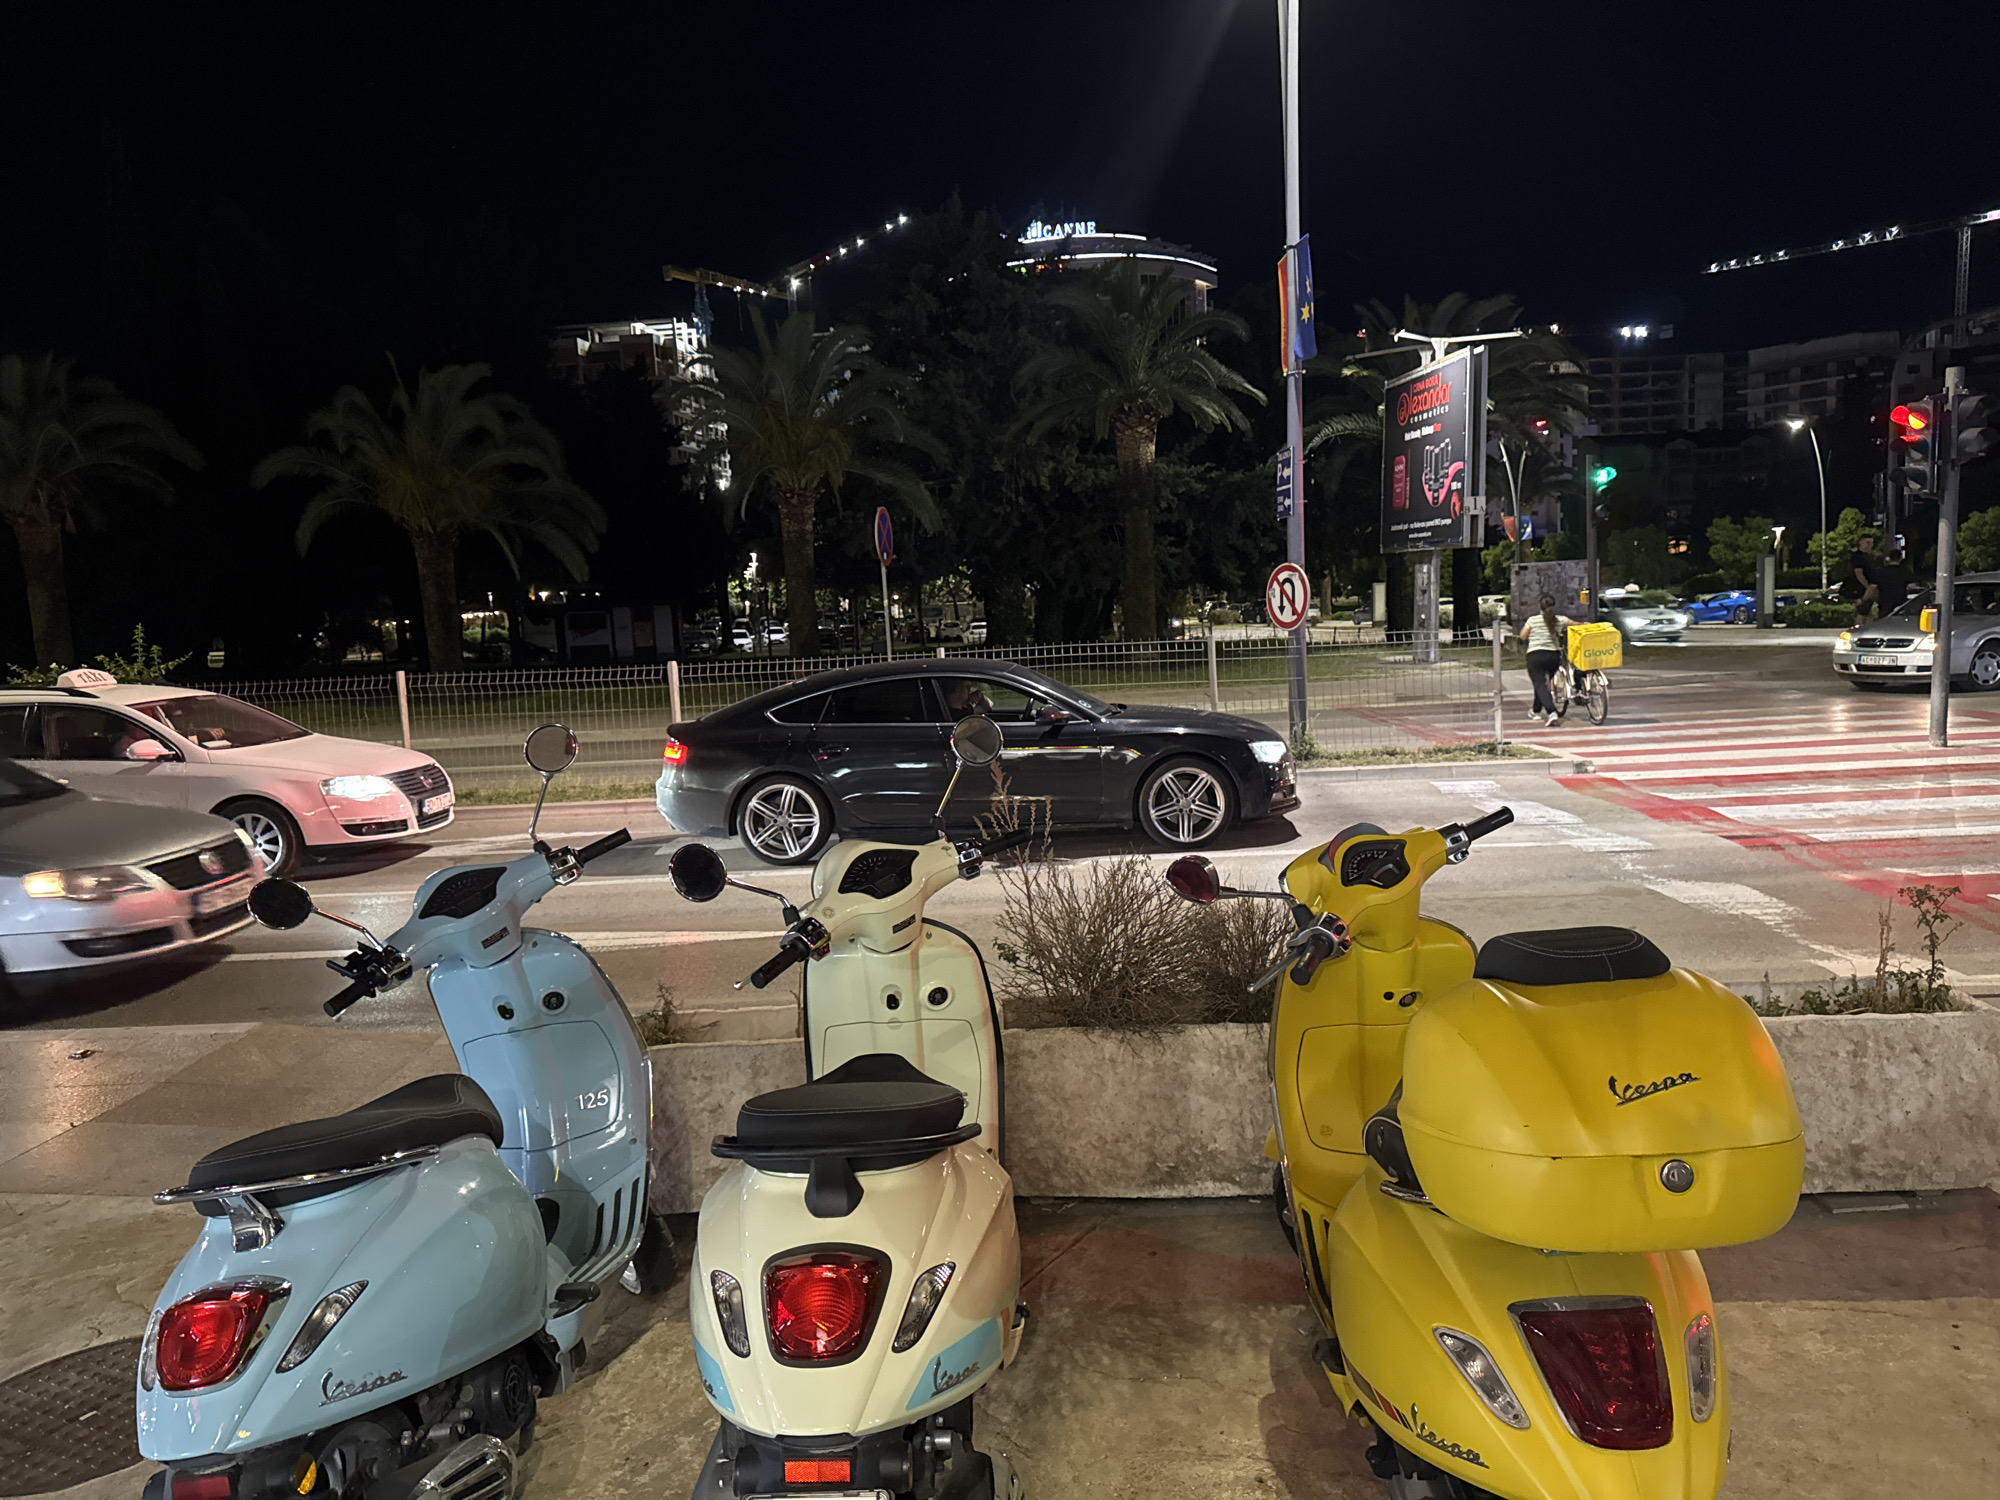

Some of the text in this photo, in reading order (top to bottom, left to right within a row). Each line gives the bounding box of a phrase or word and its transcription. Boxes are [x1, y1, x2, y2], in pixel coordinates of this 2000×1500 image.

[1043, 221, 1096, 238] CANNE
[1410, 405, 1449, 424] cosmetics
[1584, 648, 1615, 658] Glovo
[77, 671, 107, 683] TAXI
[575, 1089, 609, 1110] 125
[1608, 1073, 1701, 1106] Vespa
[319, 1367, 408, 1407] Vespa
[930, 1356, 980, 1399] Vespa
[1411, 1402, 1490, 1469] Vespa
